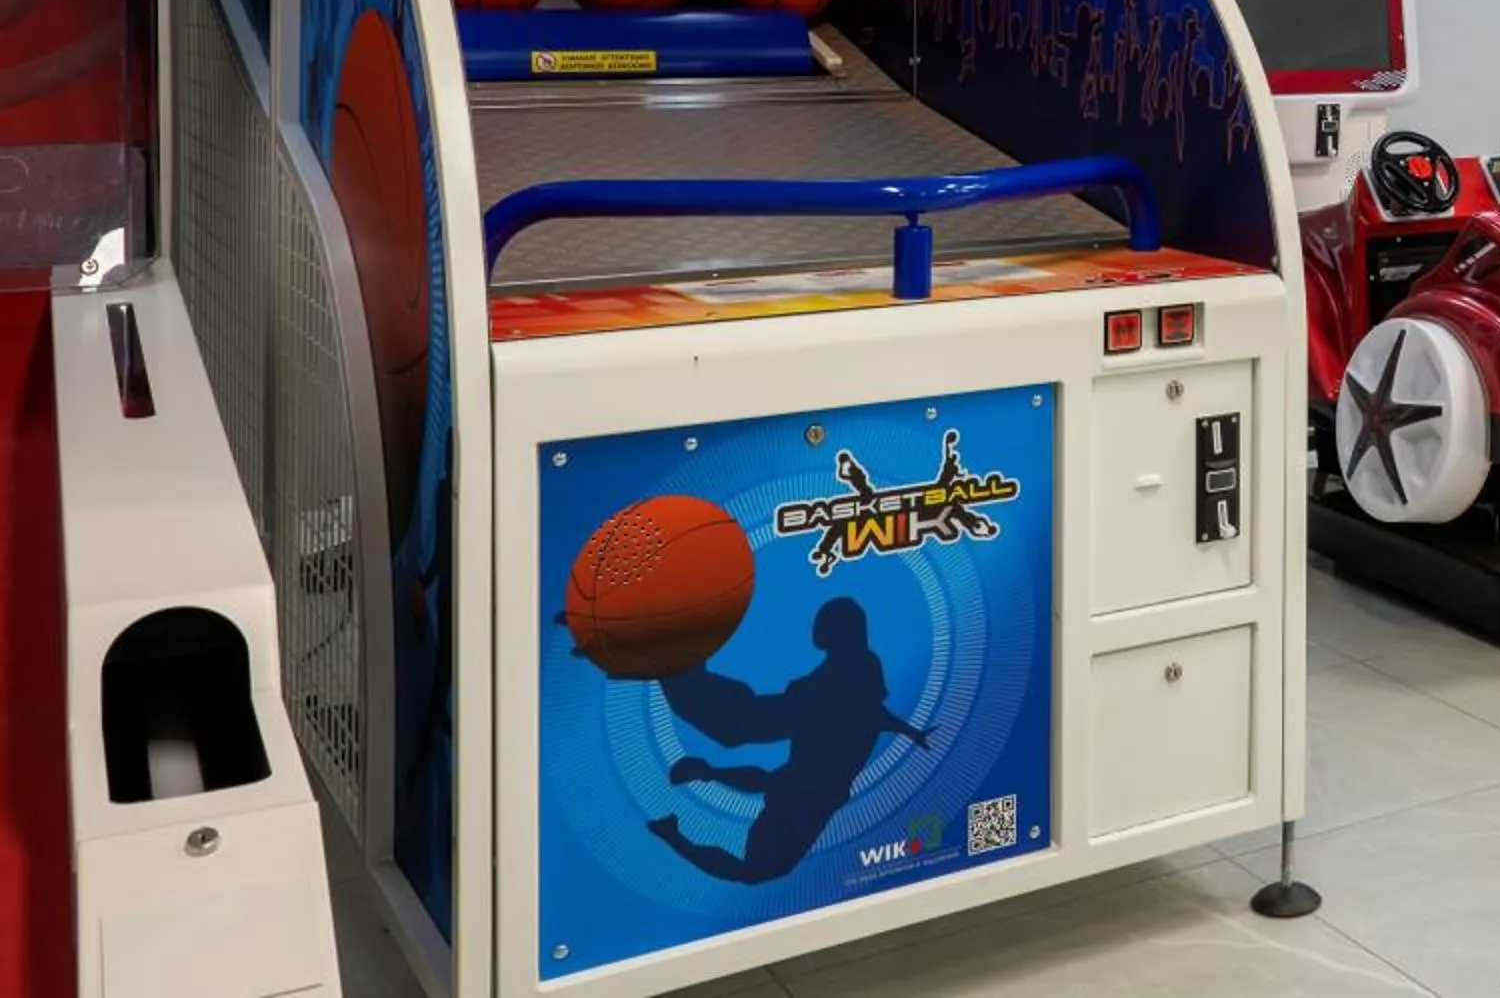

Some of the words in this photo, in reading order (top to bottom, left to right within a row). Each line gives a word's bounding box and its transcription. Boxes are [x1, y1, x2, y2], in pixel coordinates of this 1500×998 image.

[781, 477, 1015, 529] BASKETBALL
[846, 504, 954, 553] WIK
[859, 839, 907, 867] WIK
